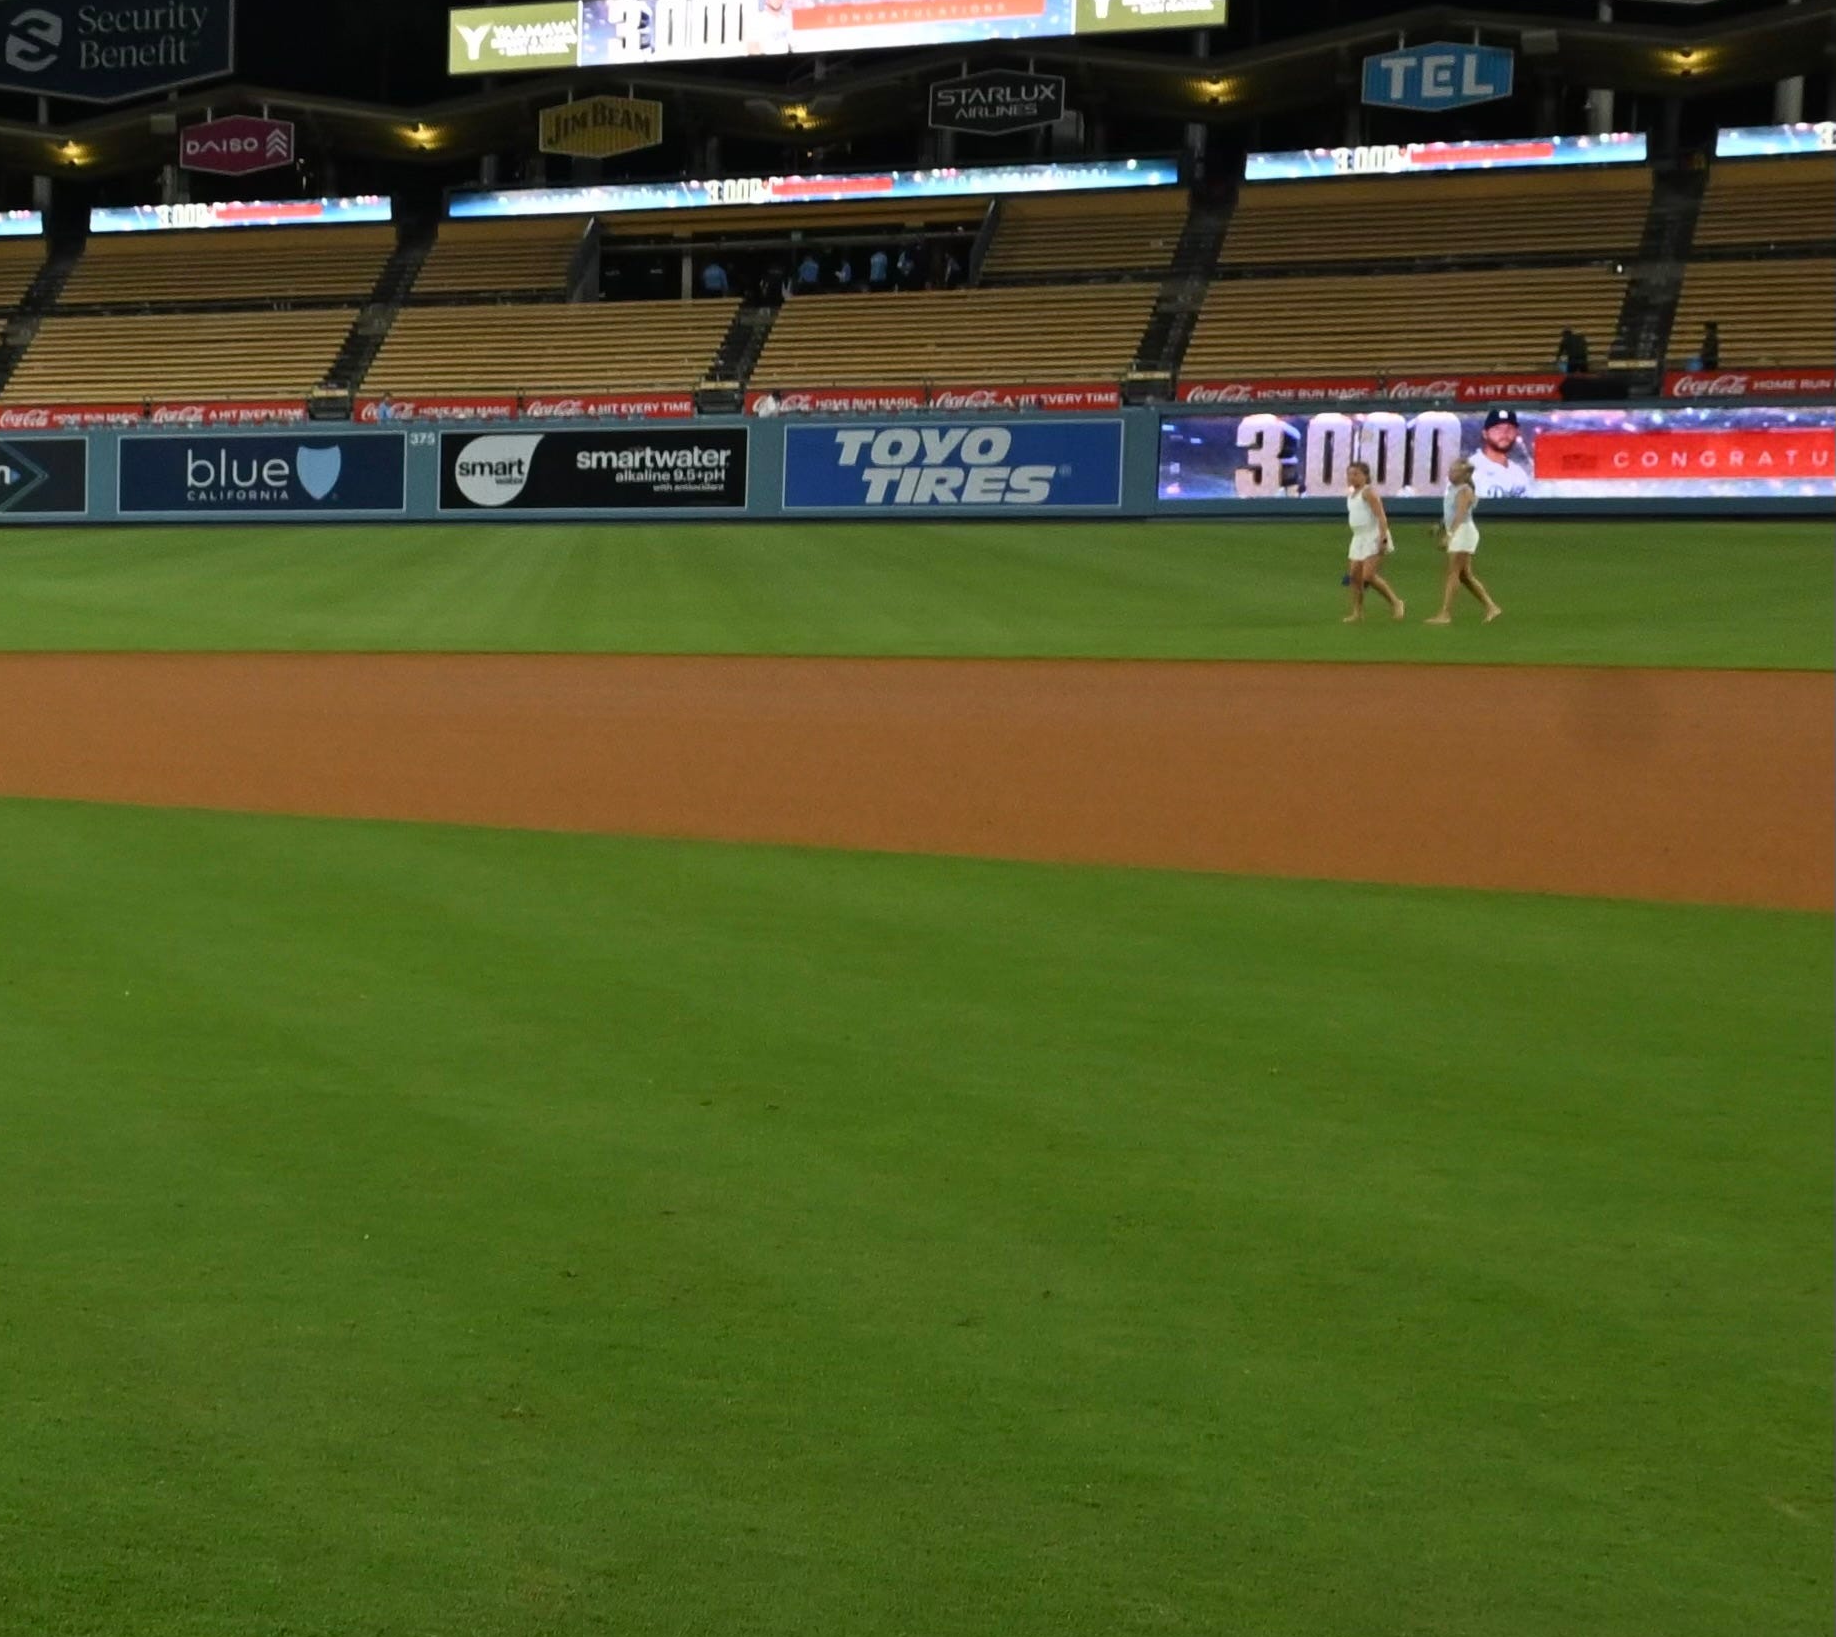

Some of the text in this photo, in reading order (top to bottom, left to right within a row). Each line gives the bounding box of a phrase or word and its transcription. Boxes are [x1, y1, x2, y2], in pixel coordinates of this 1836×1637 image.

[78, 0, 208, 34] Security
[79, 34, 191, 70] Benefit
[1382, 54, 1495, 99] TEL
[937, 83, 1056, 107] STARLUX
[953, 103, 1038, 120] AIRLINES
[548, 101, 652, 147] JIM BEAM
[186, 137, 259, 155] DAISO
[1464, 384, 1476, 396] A
[1479, 384, 1504, 396] HIT
[1507, 384, 1556, 396] EVERY
[1673, 374, 1749, 397] Coca-Cola
[1087, 393, 1119, 405] TIME
[576, 445, 731, 470] smartwater
[835, 427, 1012, 465] TOYO
[186, 448, 290, 488] blue
[458, 458, 525, 478] smart
[615, 469, 670, 484] alkaline
[186, 490, 289, 502] CALIFORNIA
[862, 465, 1057, 505] TIRES
